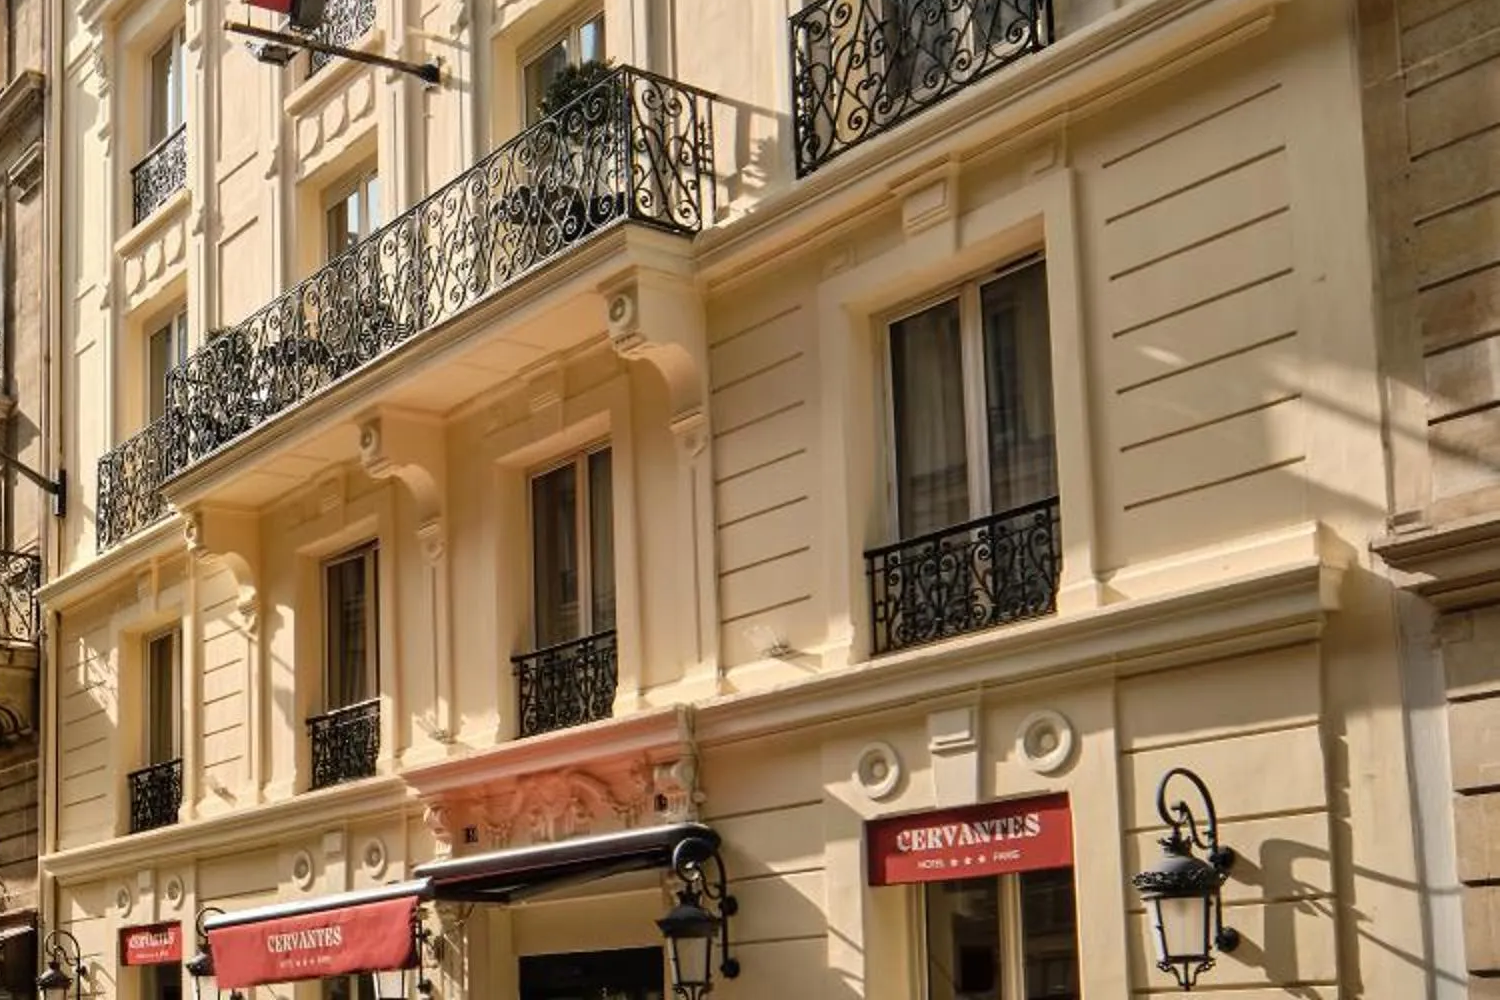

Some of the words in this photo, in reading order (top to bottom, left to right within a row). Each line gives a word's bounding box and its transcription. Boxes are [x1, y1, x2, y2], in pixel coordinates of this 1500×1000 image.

[897, 812, 1041, 851] CERVANTES
[918, 859, 945, 869] HOTEL
[267, 925, 343, 953] CERVANTES
